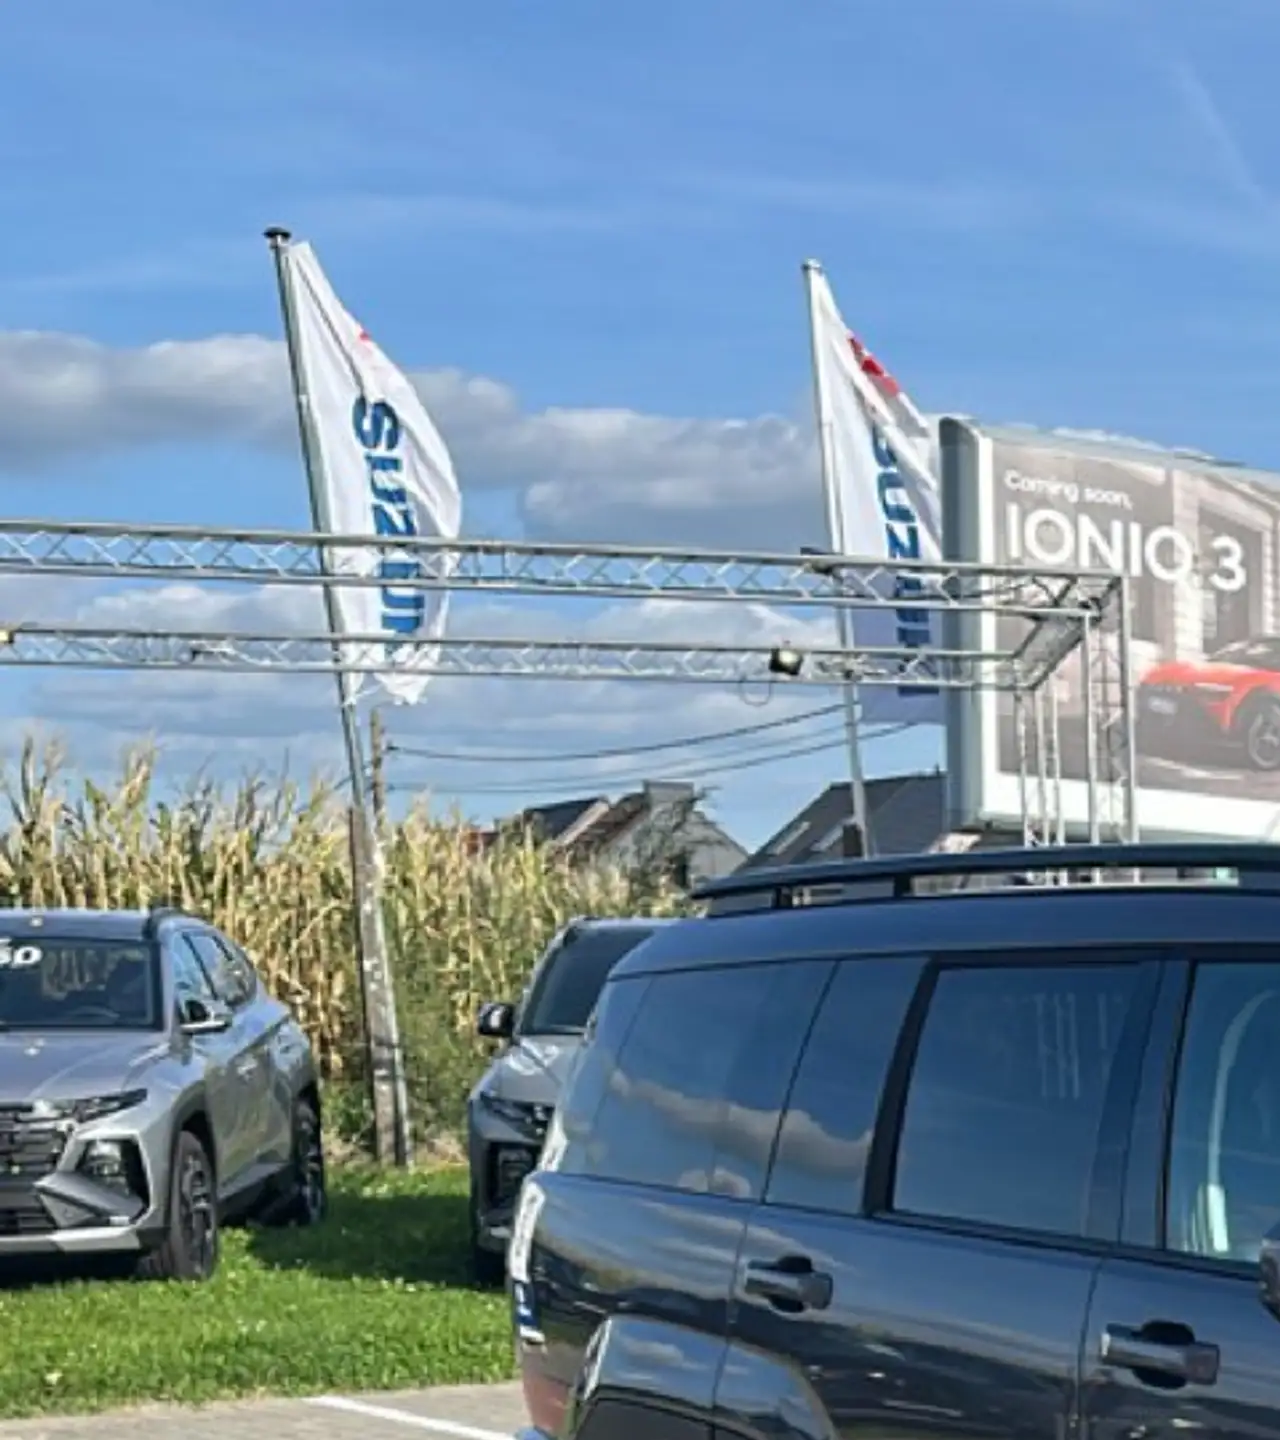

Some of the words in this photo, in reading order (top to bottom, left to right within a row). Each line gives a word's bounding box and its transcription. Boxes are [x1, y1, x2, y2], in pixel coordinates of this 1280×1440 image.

[1003, 469, 1079, 503] Coming
[1005, 501, 1203, 589] IONIQ
[1208, 534, 1247, 593] 3
